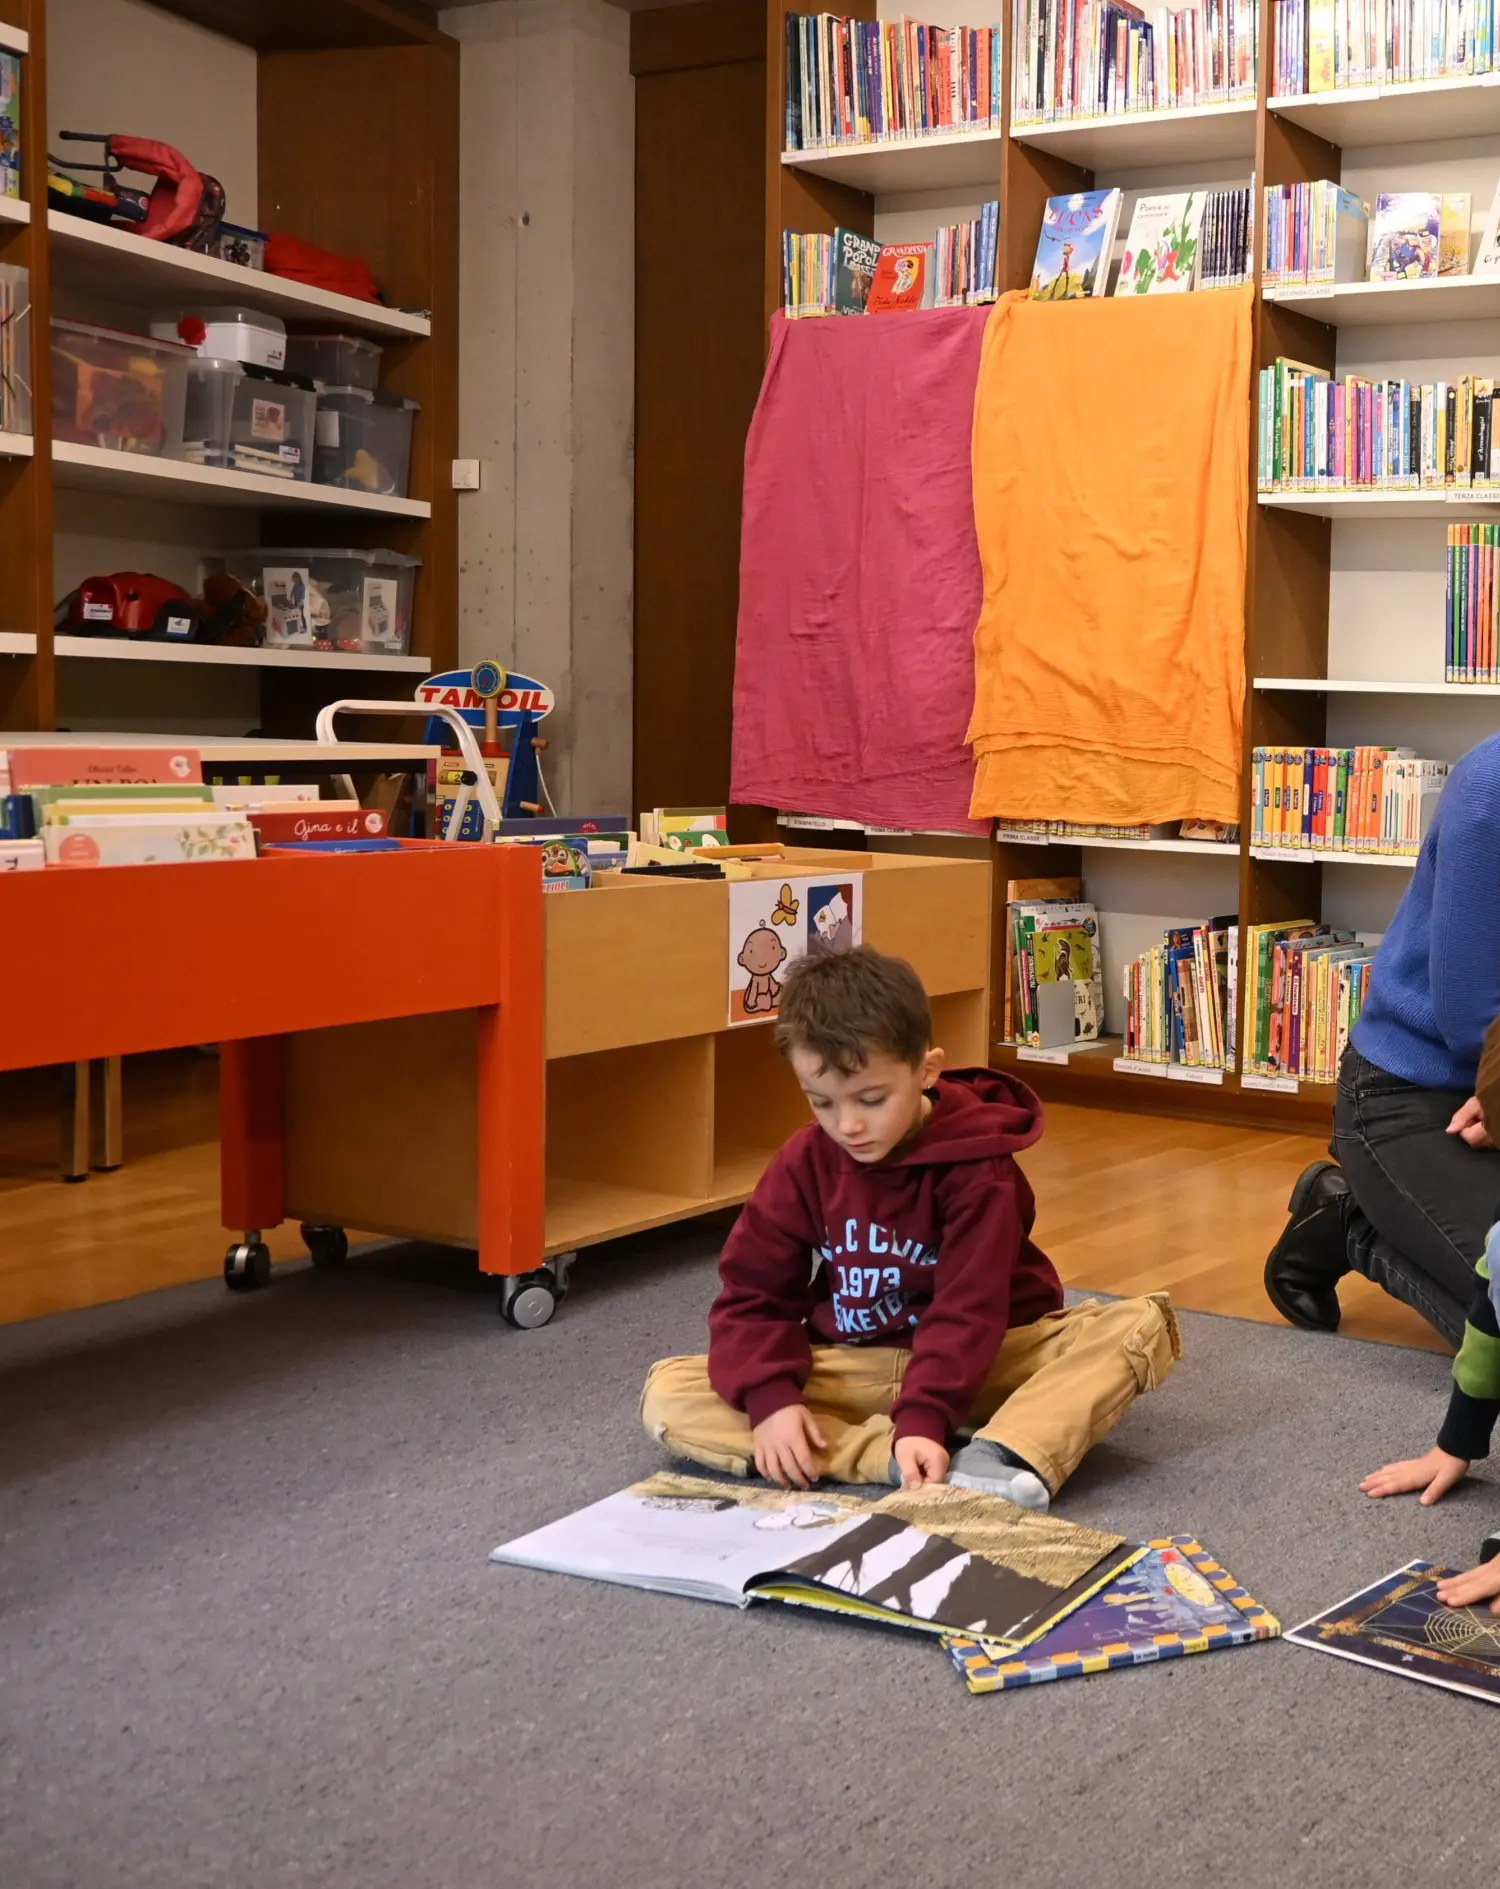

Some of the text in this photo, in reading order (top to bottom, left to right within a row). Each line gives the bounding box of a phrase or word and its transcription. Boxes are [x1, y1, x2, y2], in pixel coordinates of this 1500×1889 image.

[843, 233, 881, 254] GRAND
[843, 247, 878, 267] POPOL
[1454, 492, 1500, 501] TERZA CLASSE
[419, 687, 549, 711] TAMOIL
[294, 818, 358, 840] Gina e il
[1003, 833, 1041, 842] PRIMA CLASSE
[837, 1266, 901, 1298] 1973
